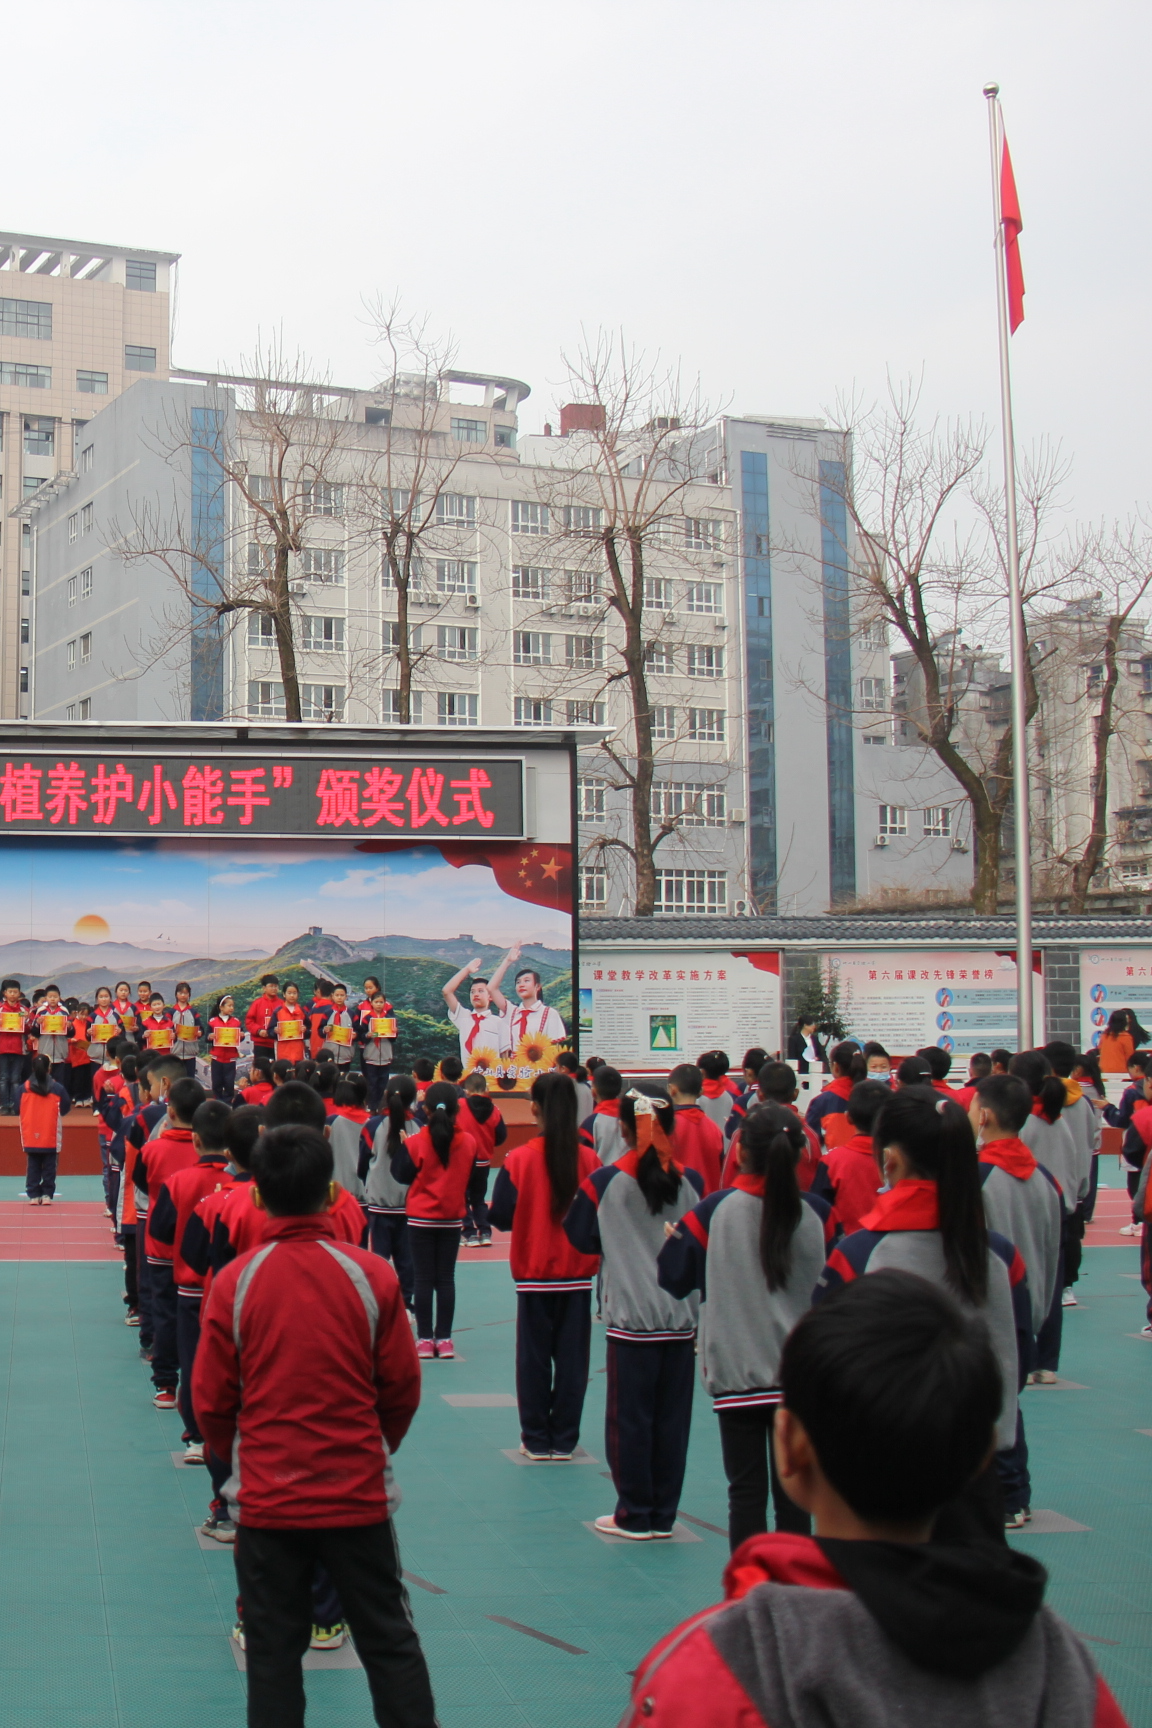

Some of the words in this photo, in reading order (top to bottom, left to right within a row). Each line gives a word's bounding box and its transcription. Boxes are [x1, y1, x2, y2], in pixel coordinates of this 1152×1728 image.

[316, 766, 496, 829] 颁奖仪式
[593, 970, 727, 981] 课堂教学改革实施方案
[868, 969, 994, 981] 第六届课改先锋荣誉榜
[1125, 966, 1152, 976] 第六
